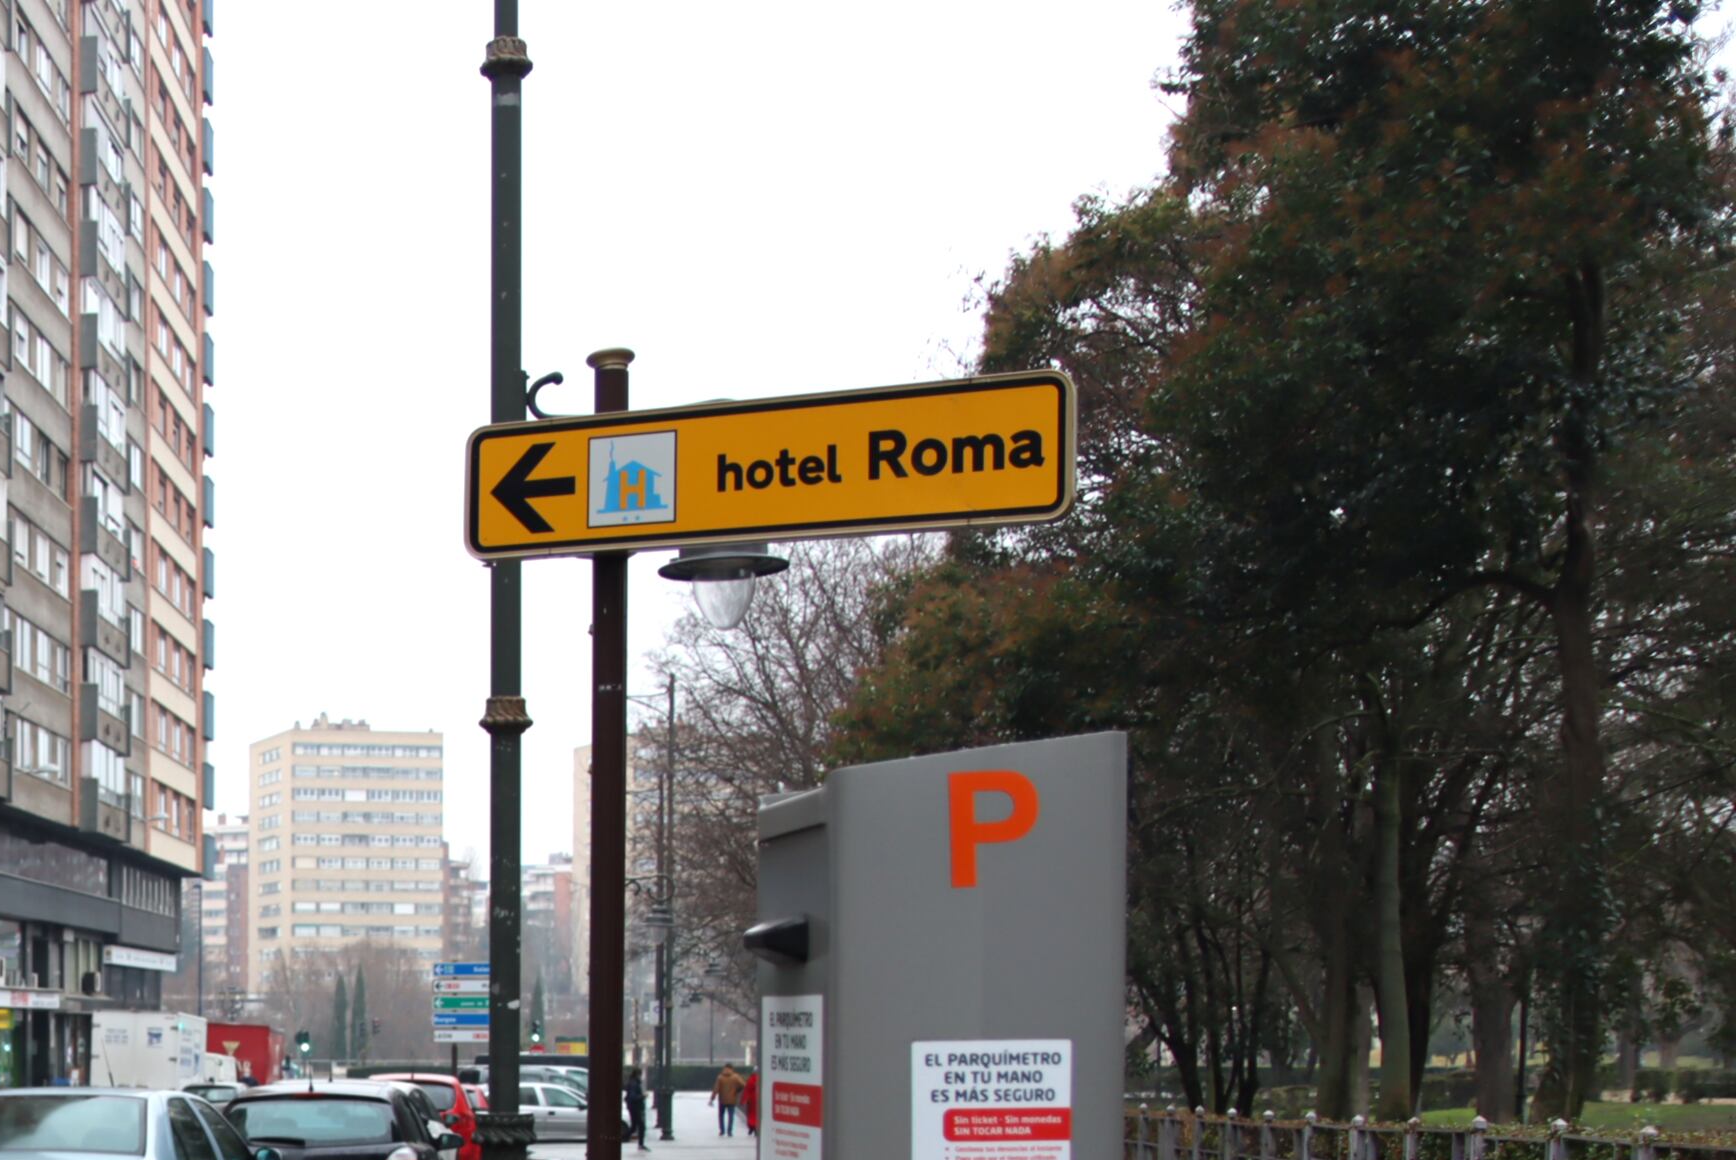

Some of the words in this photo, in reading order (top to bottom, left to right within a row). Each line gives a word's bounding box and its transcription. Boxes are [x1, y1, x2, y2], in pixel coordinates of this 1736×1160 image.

[717, 444, 842, 492] hotel
[868, 428, 1046, 480] Roma
[947, 769, 1039, 889] P
[924, 1053, 942, 1067] EL
[947, 1050, 1062, 1068] PARQUÍMETRO
[944, 1071, 965, 1084] EN
[971, 1071, 991, 1084] TU
[996, 1070, 1043, 1084] MANO
[930, 1089, 950, 1103] ES
[954, 1086, 989, 1102] MÁS
[993, 1088, 1056, 1102] SEGURO
[953, 1115, 969, 1124] Sin
[971, 1115, 998, 1124] ticket
[1004, 1115, 1019, 1124] Sin
[1021, 1115, 1062, 1124] monedas
[953, 1126, 970, 1136] SIN
[973, 1126, 1003, 1136] TOCAR
[1004, 1126, 1032, 1135] NADA
